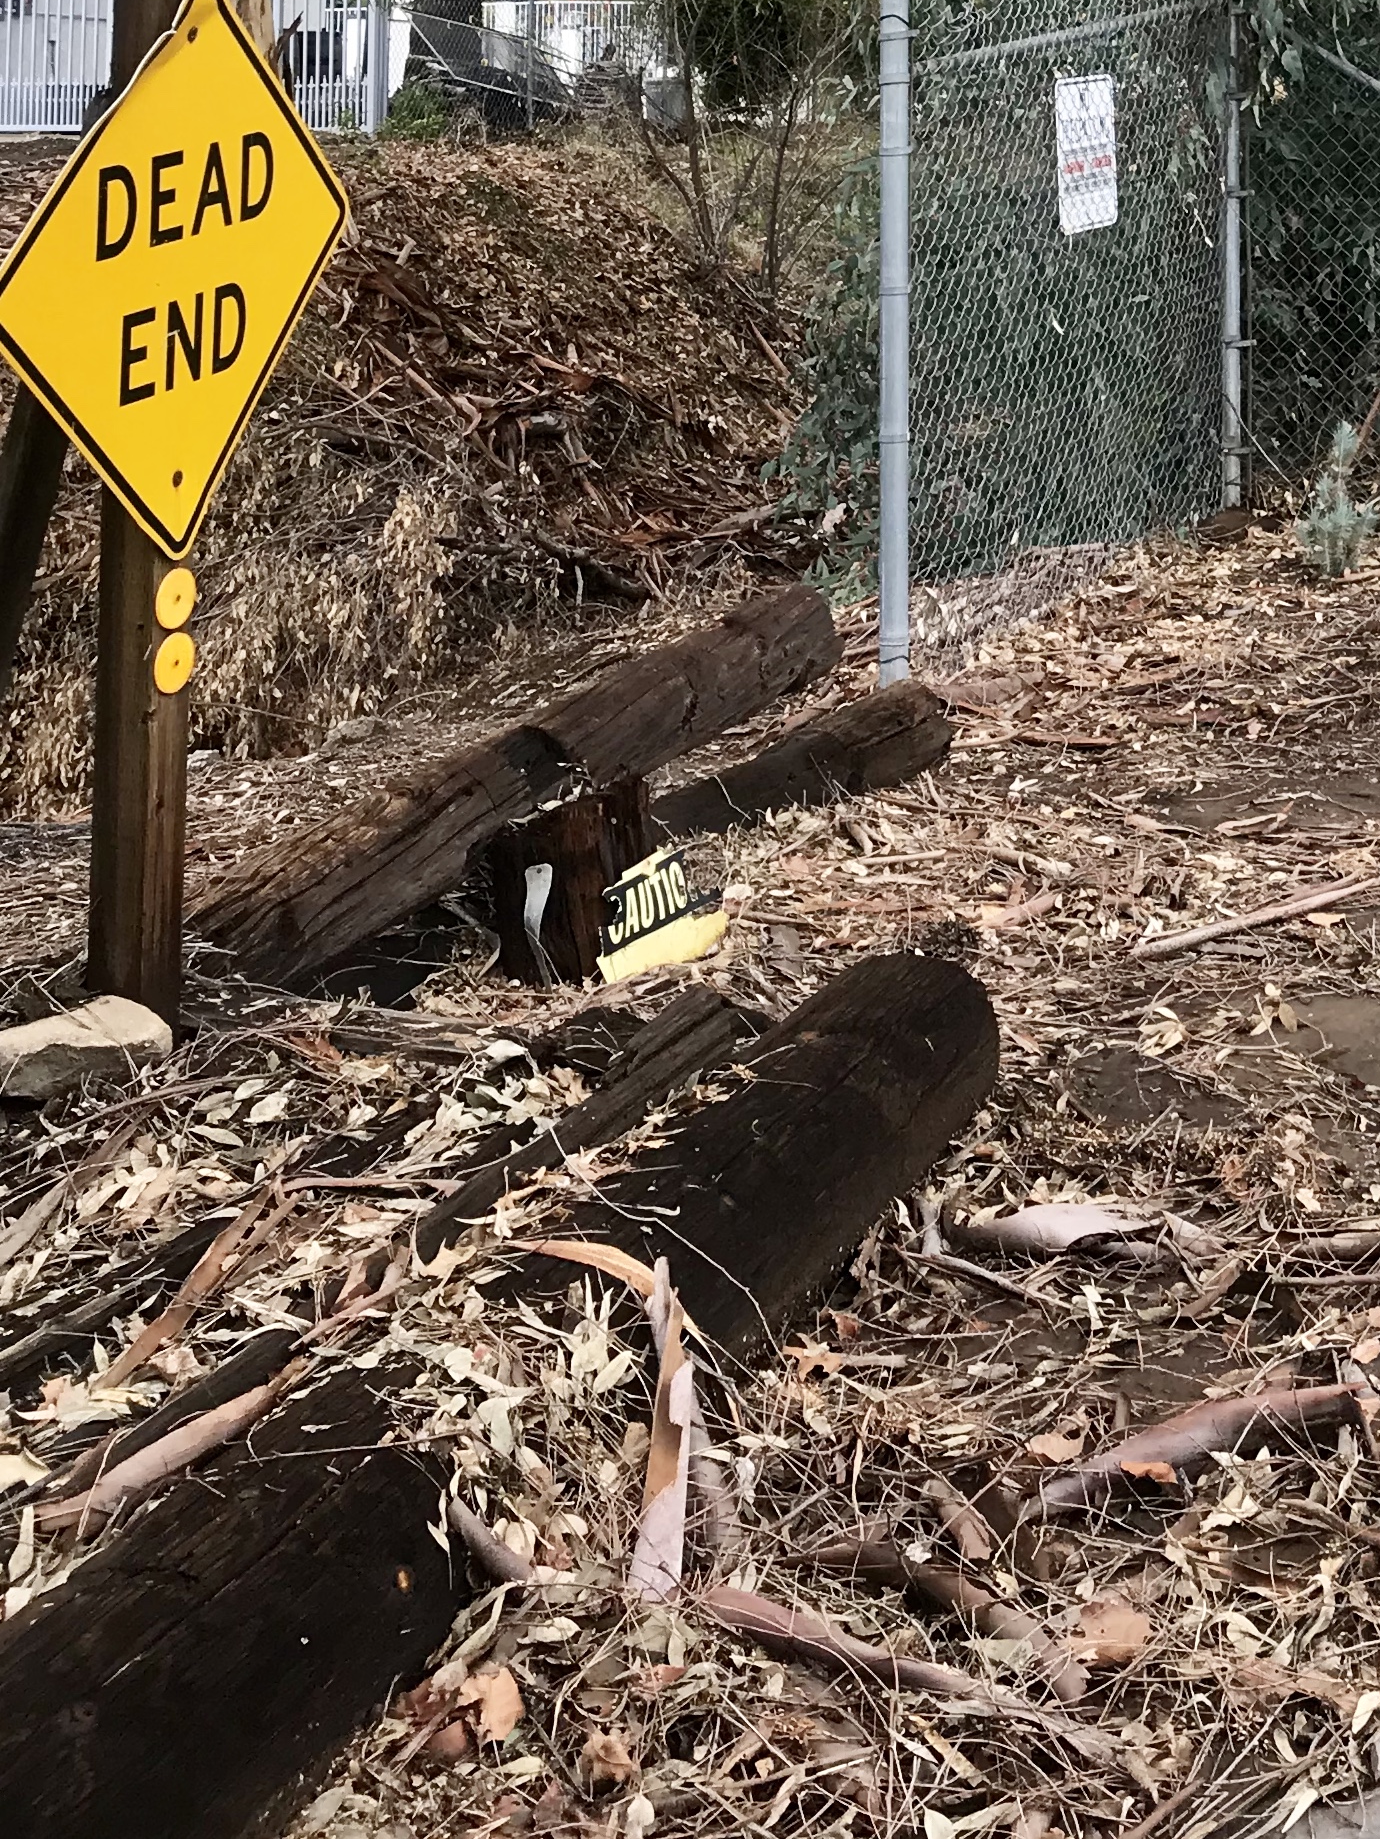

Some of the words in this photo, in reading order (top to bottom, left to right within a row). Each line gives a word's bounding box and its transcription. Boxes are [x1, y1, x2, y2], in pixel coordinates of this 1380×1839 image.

[95, 131, 274, 262] DEAD
[119, 282, 247, 407] END
[607, 861, 699, 945] CAUTIO
